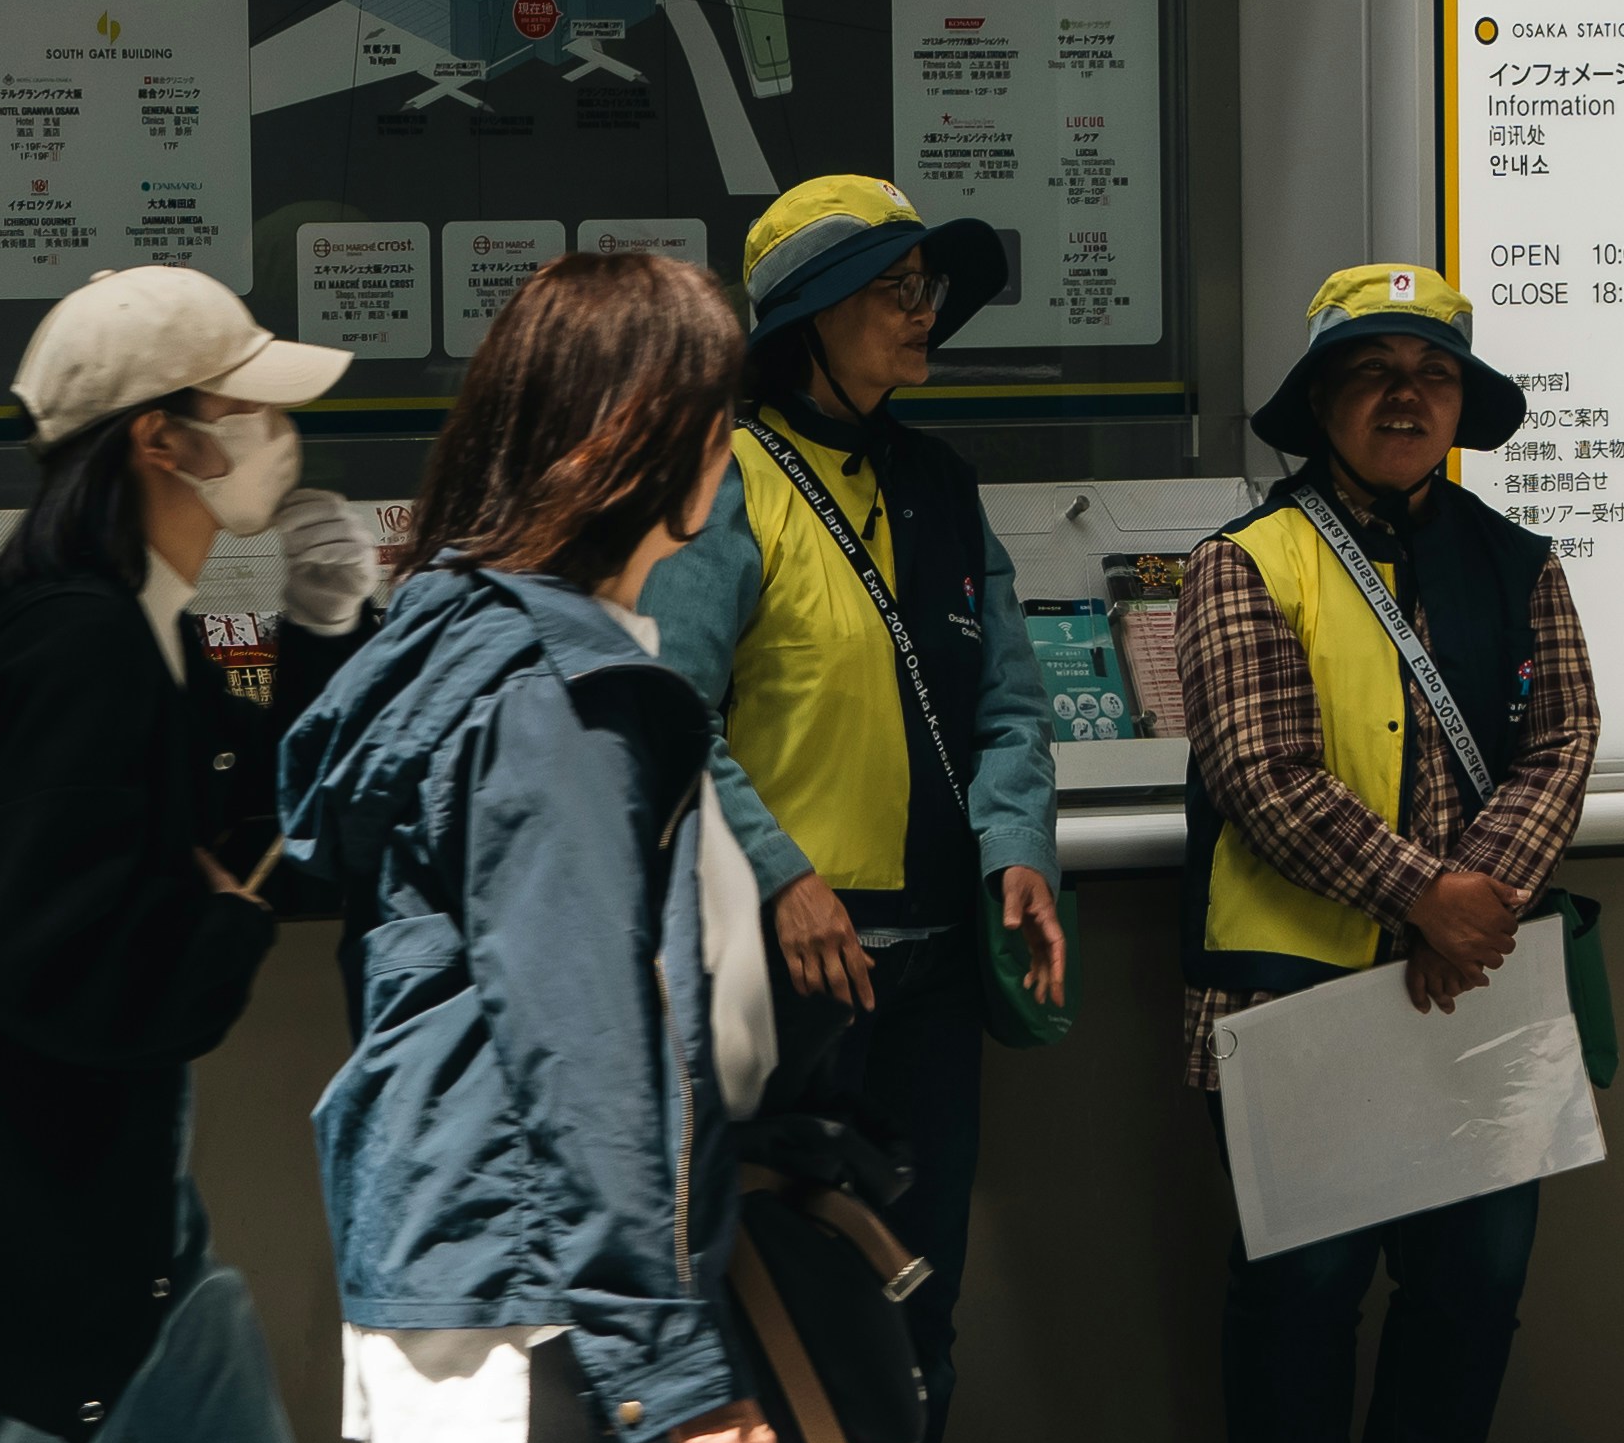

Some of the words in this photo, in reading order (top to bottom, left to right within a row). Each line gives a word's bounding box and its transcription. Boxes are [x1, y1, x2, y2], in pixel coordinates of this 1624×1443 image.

[518, 1, 553, 15] 現在地
[1512, 23, 1567, 39] OSAKA
[1057, 35, 1115, 46] サポートプラザ
[46, 49, 83, 59] SOUTH
[89, 49, 117, 59] GATE
[122, 48, 172, 59] BUILDING
[363, 44, 401, 54] 京都方面
[1092, 50, 1113, 59] PLAZA
[138, 88, 200, 99] 総合クリニック
[22, 107, 53, 115] GRANVIA
[56, 106, 80, 115] OSAKA
[142, 106, 174, 115] GENERAL
[176, 106, 199, 114] CLINIC
[1488, 95, 1615, 116] Information
[923, 133, 1012, 143] 大阪ステーションシティシネマ
[1073, 133, 1099, 142] ルクア
[1489, 125, 1545, 146] 问讯处
[921, 149, 942, 158] OSAKA
[944, 149, 971, 158] STATION
[973, 149, 988, 158] CITY
[989, 149, 1015, 158] CINEMA
[1490, 154, 1550, 177] 안내소
[8, 200, 72, 211] イチロクグルメ
[148, 198, 196, 209] 大丸梅田店
[4, 218, 39, 226] ICHIROKU
[41, 218, 76, 226] GOURMET
[177, 216, 202, 224] UMEDA
[1062, 253, 1089, 263] ルクア
[1091, 253, 1115, 262] イーレ
[1491, 244, 1560, 266] OPEN
[314, 264, 414, 275] エキマルシェ大阪クロスト
[471, 262, 538, 273] エキマルシェ大阪
[314, 280, 326, 289] EKI
[328, 278, 359, 289] MARCHÉ
[362, 280, 387, 289] OSAKA
[390, 279, 414, 288] CROST
[468, 278, 480, 287] EKI
[483, 276, 513, 287] MARCHÉ
[1491, 282, 1569, 305] CLOSE
[1520, 408, 1609, 430] 内のご案内
[861, 568, 888, 612] Expo
[885, 610, 913, 654] 2025
